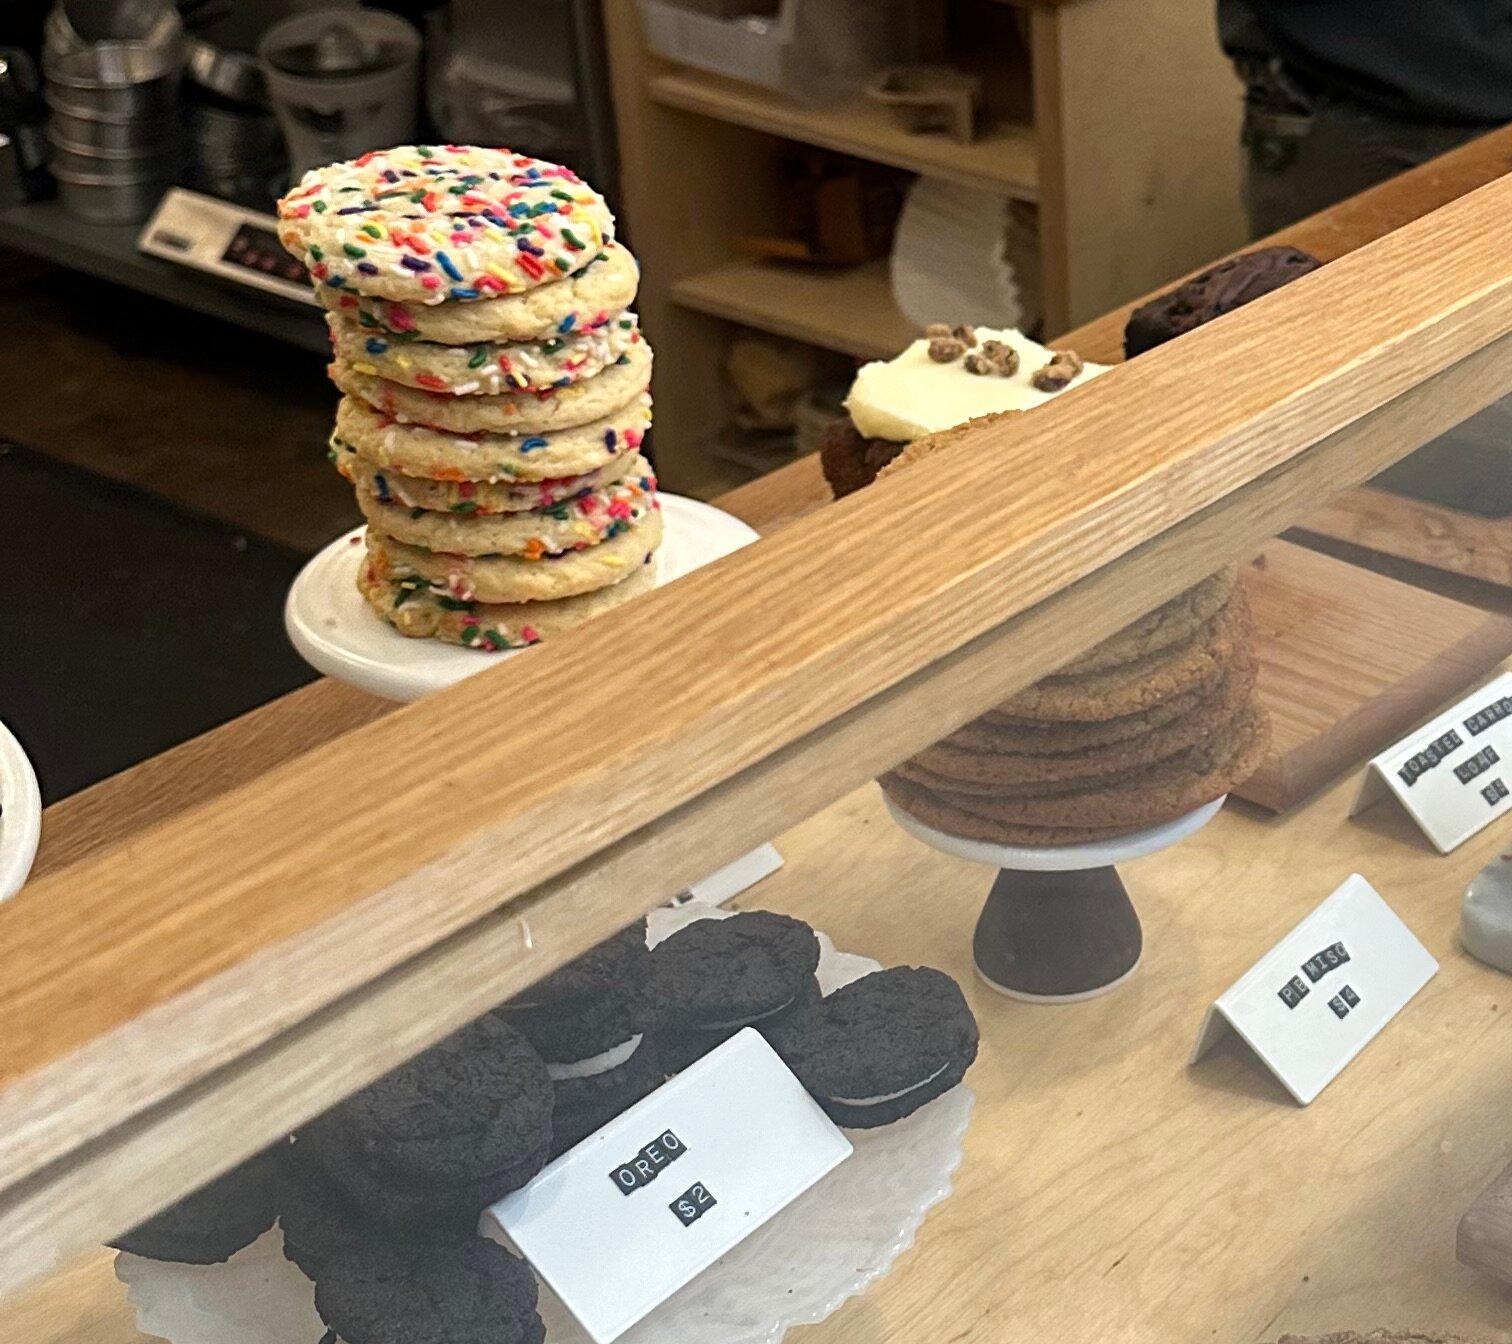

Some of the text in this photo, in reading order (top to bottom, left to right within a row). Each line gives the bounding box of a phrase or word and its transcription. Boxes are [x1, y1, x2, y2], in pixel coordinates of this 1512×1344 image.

[1400, 730, 1462, 781] TOASTED
[1280, 941, 1350, 1006] PB MISO
[1329, 986, 1358, 1016] $4
[612, 1130, 684, 1190] OREO
[674, 1184, 713, 1221] $2
